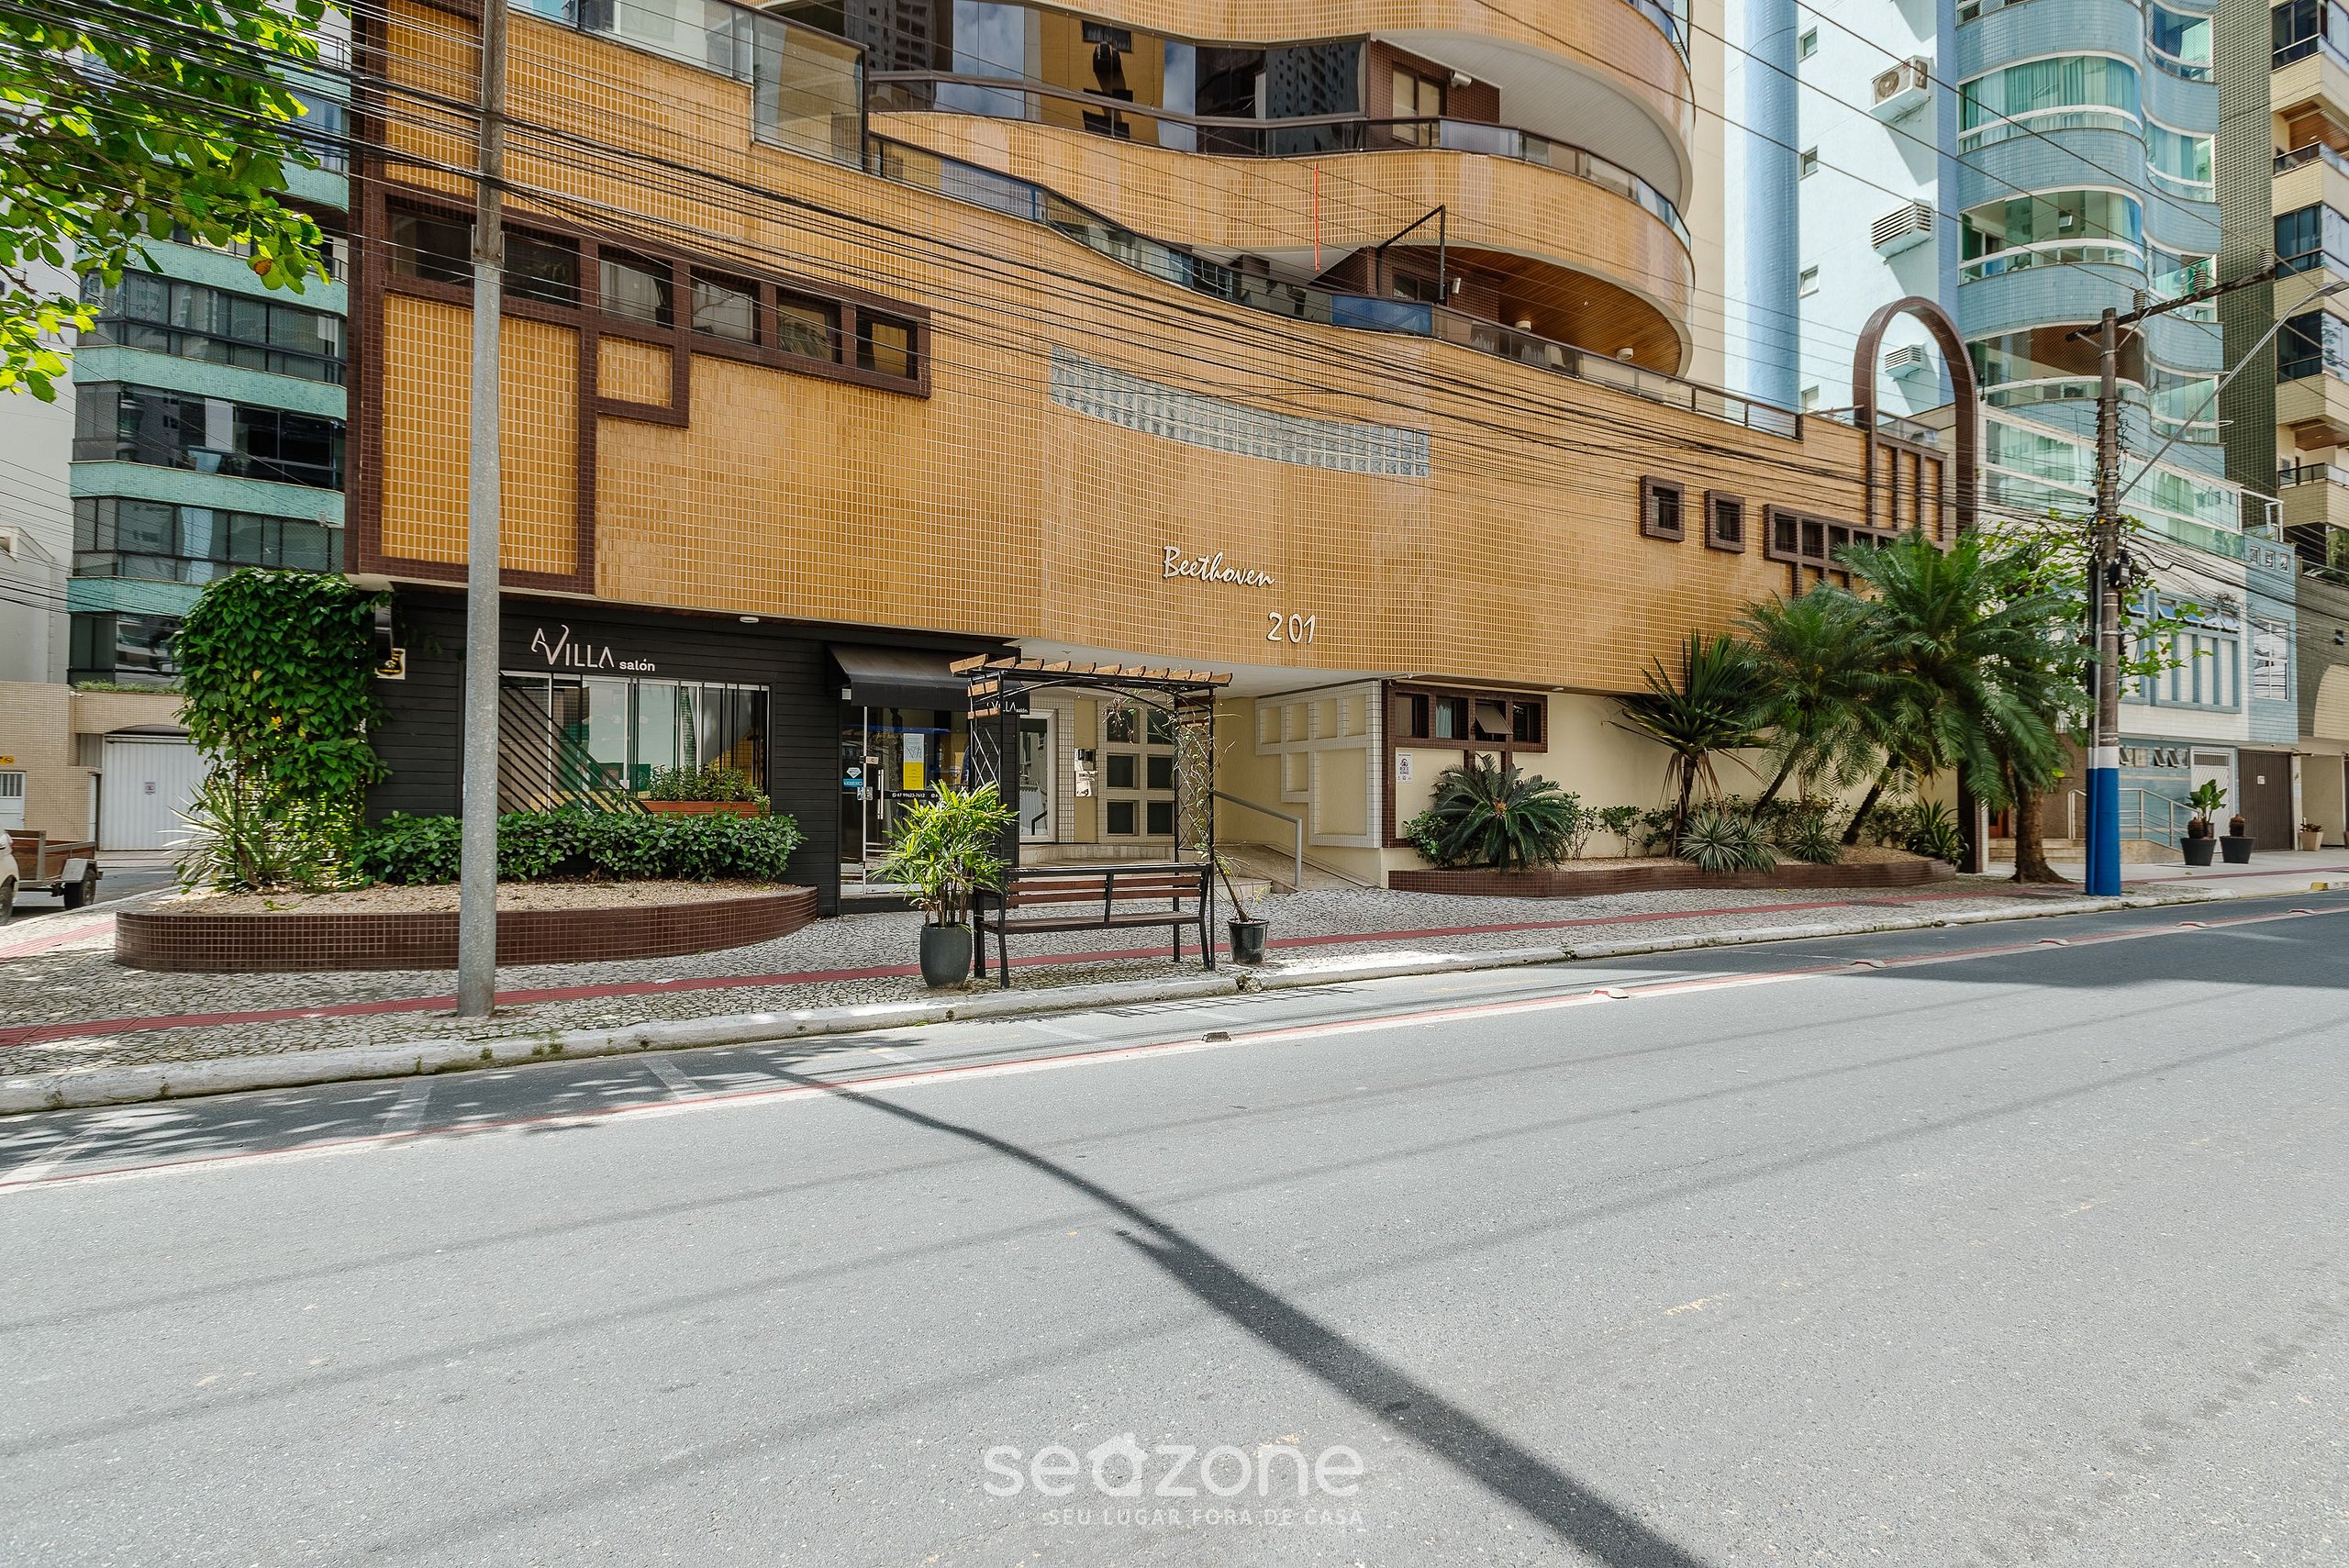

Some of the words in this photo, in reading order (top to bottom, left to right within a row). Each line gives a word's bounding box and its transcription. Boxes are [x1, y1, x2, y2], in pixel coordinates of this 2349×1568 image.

[1163, 545, 1275, 588] Beethoven
[1266, 611, 1316, 644] 201
[618, 658, 656, 672] salón
